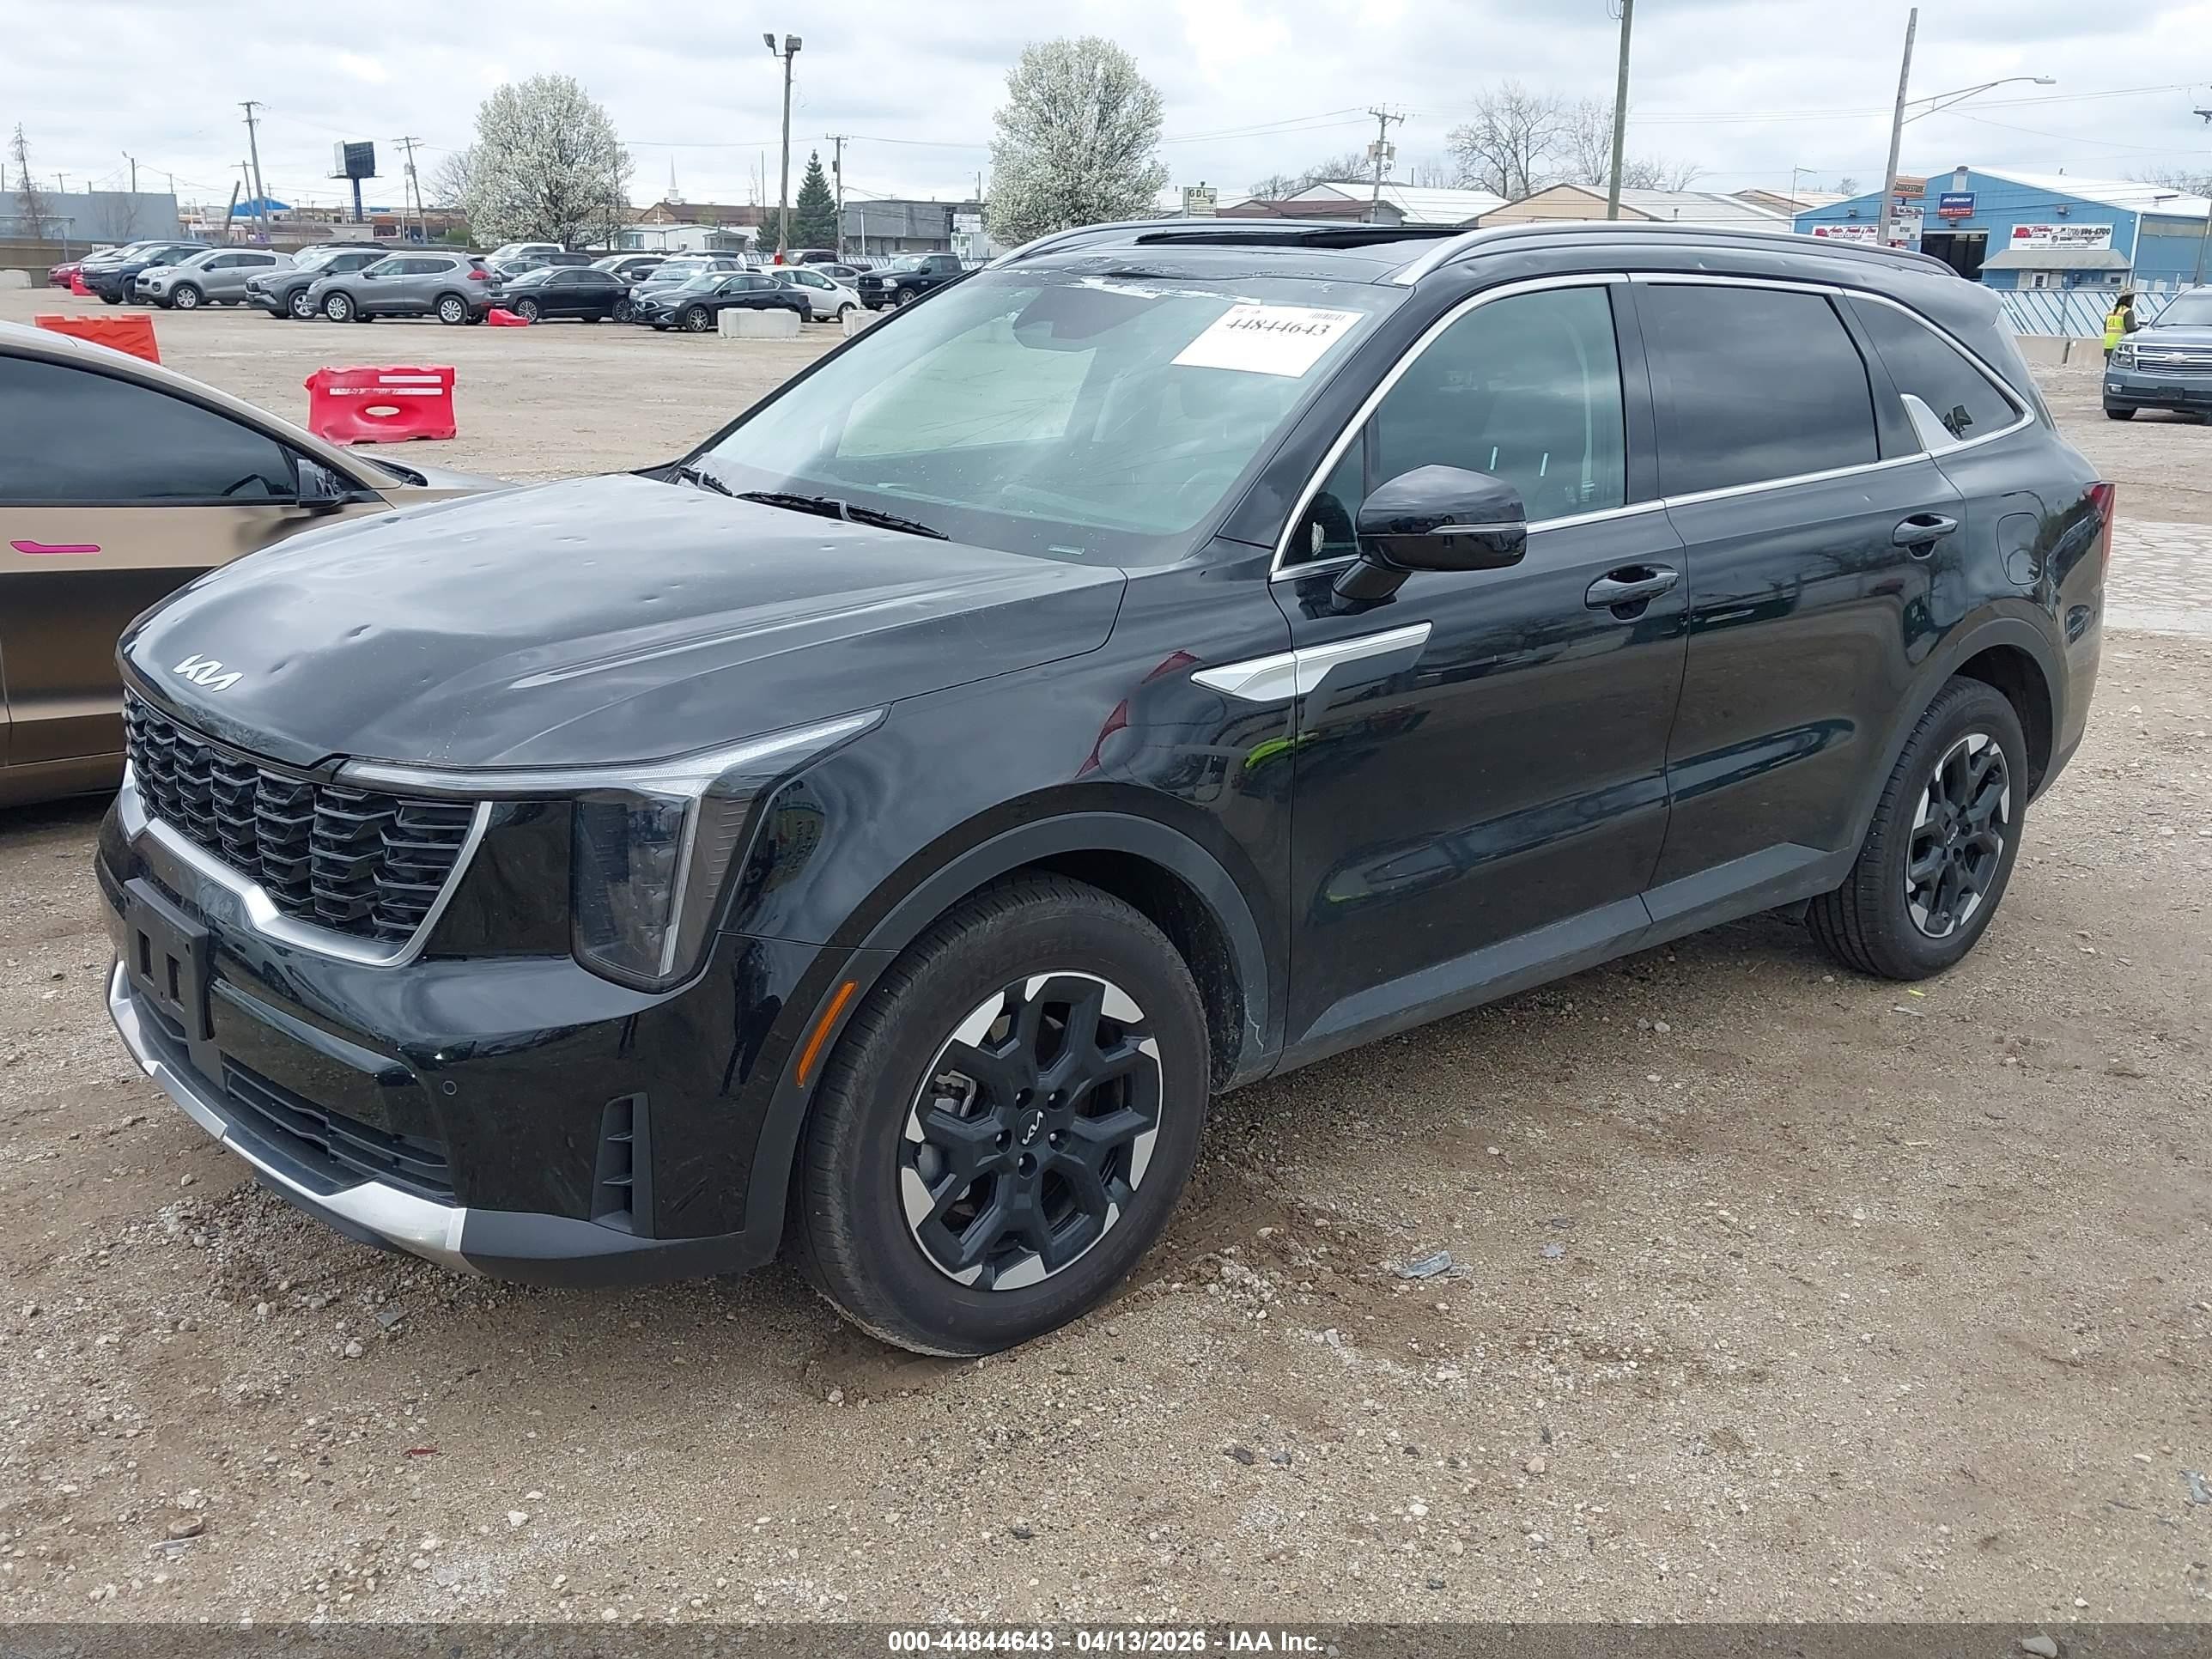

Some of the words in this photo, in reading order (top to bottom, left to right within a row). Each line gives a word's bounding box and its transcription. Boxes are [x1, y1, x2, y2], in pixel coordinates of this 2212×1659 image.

[1189, 189, 1208, 198] GDL
[1226, 319, 1331, 337] 44844643
[173, 653, 244, 692] KIA
